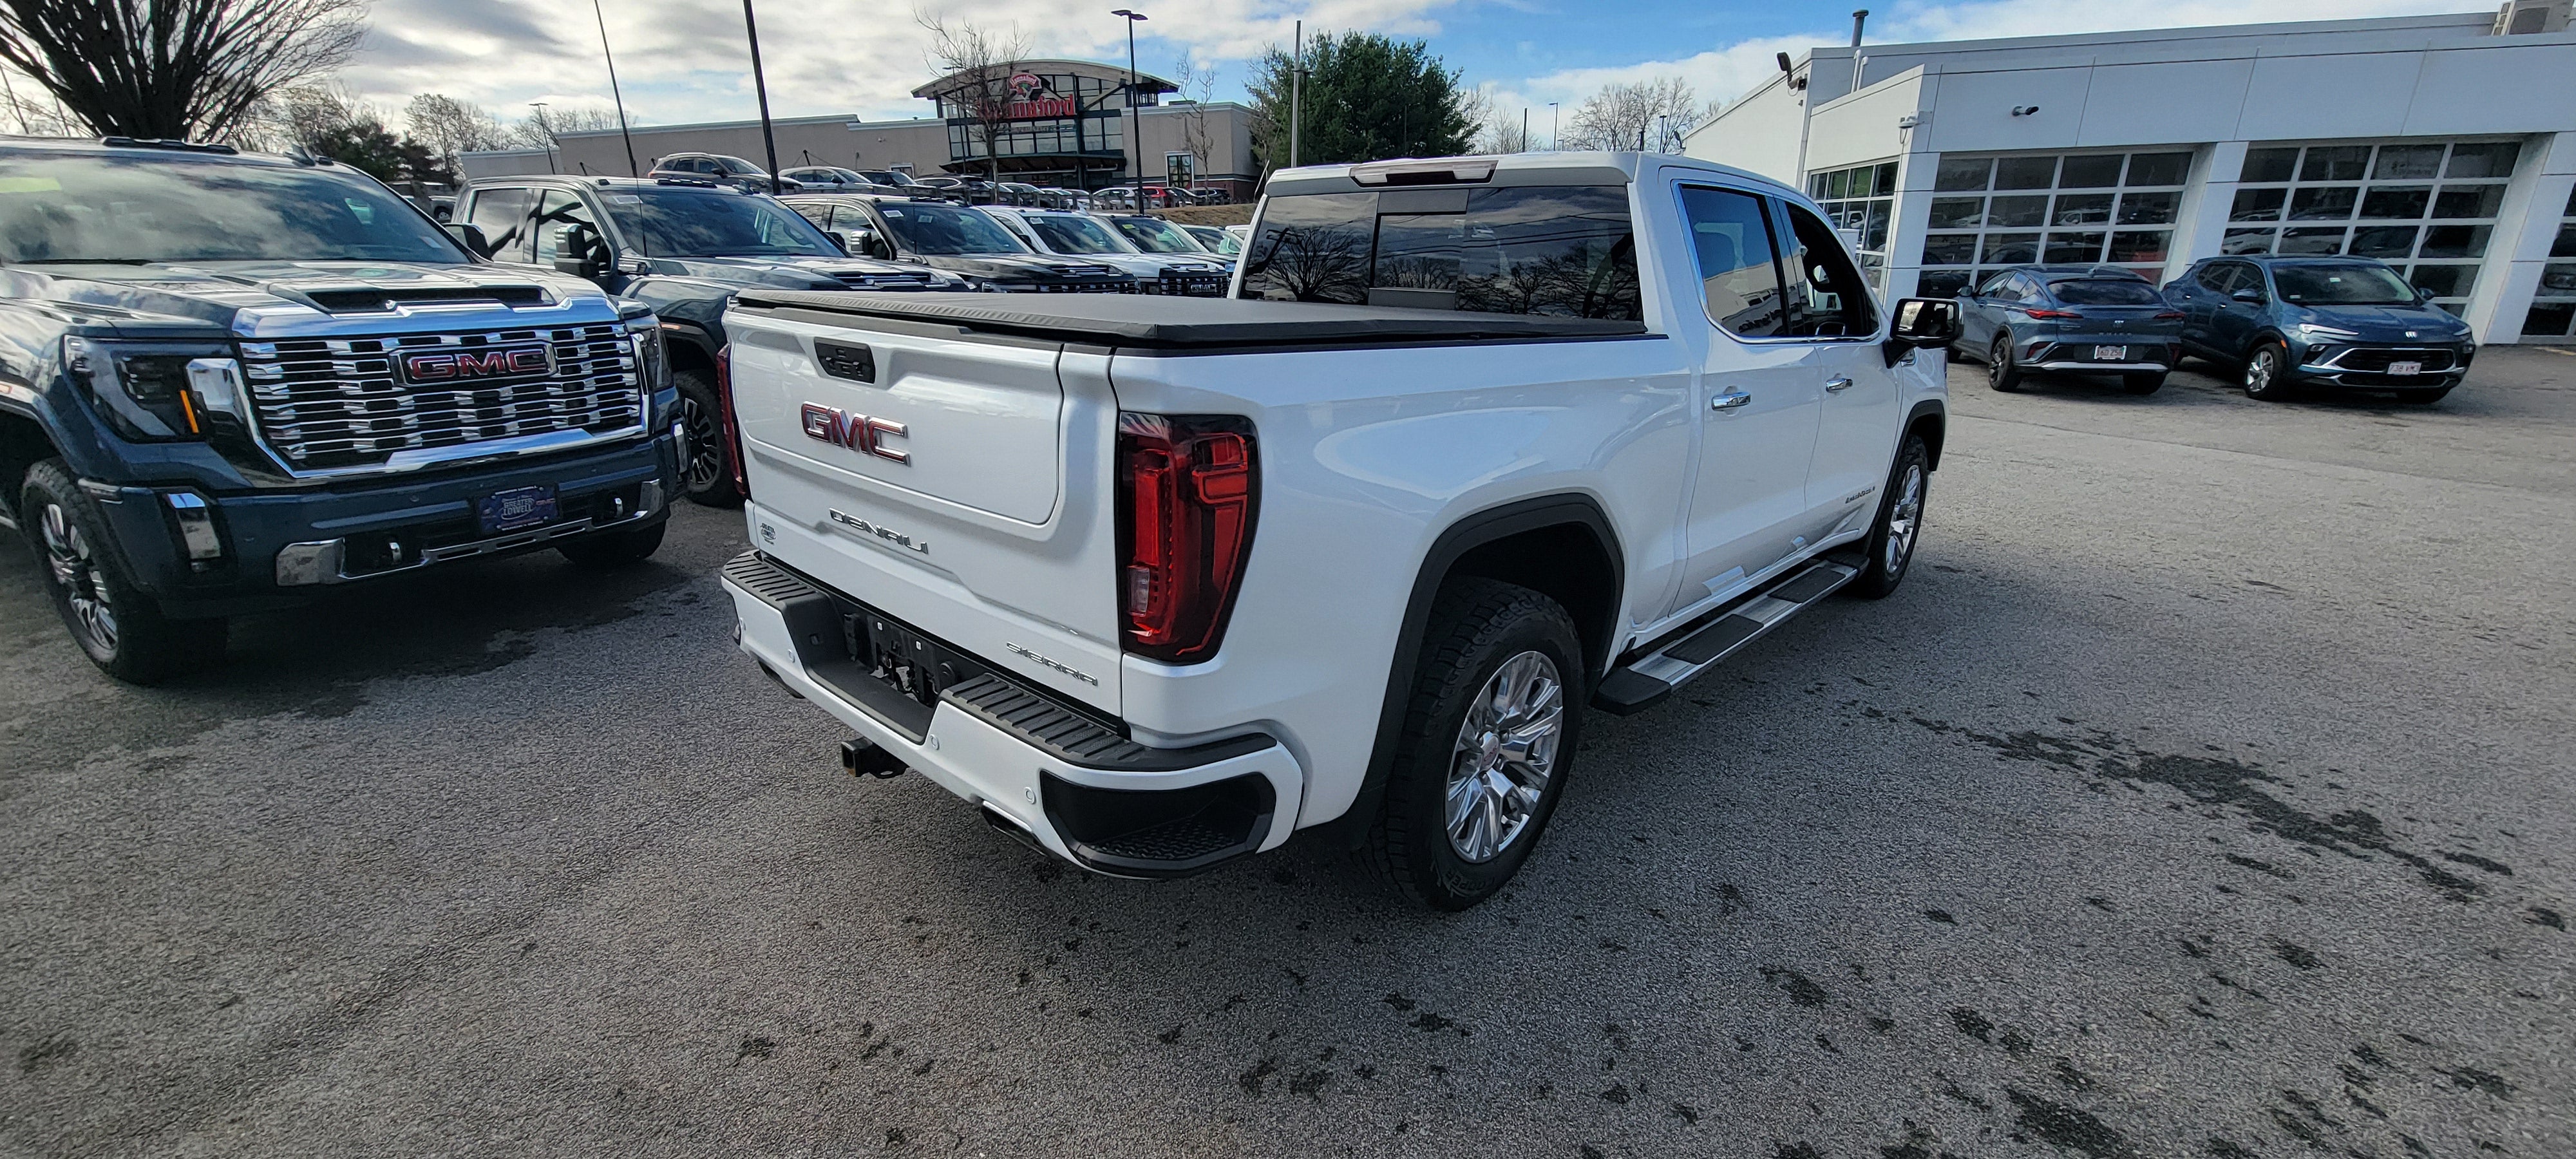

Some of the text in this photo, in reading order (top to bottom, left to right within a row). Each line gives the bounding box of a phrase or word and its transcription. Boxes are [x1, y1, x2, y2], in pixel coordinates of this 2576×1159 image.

[407, 349, 547, 380] GMC
[801, 400, 912, 468] GMC
[503, 504, 533, 516] LOWELL
[504, 498, 534, 509] GREATER
[829, 507, 928, 554] DENALI
[1007, 641, 1097, 686] SIERRA
